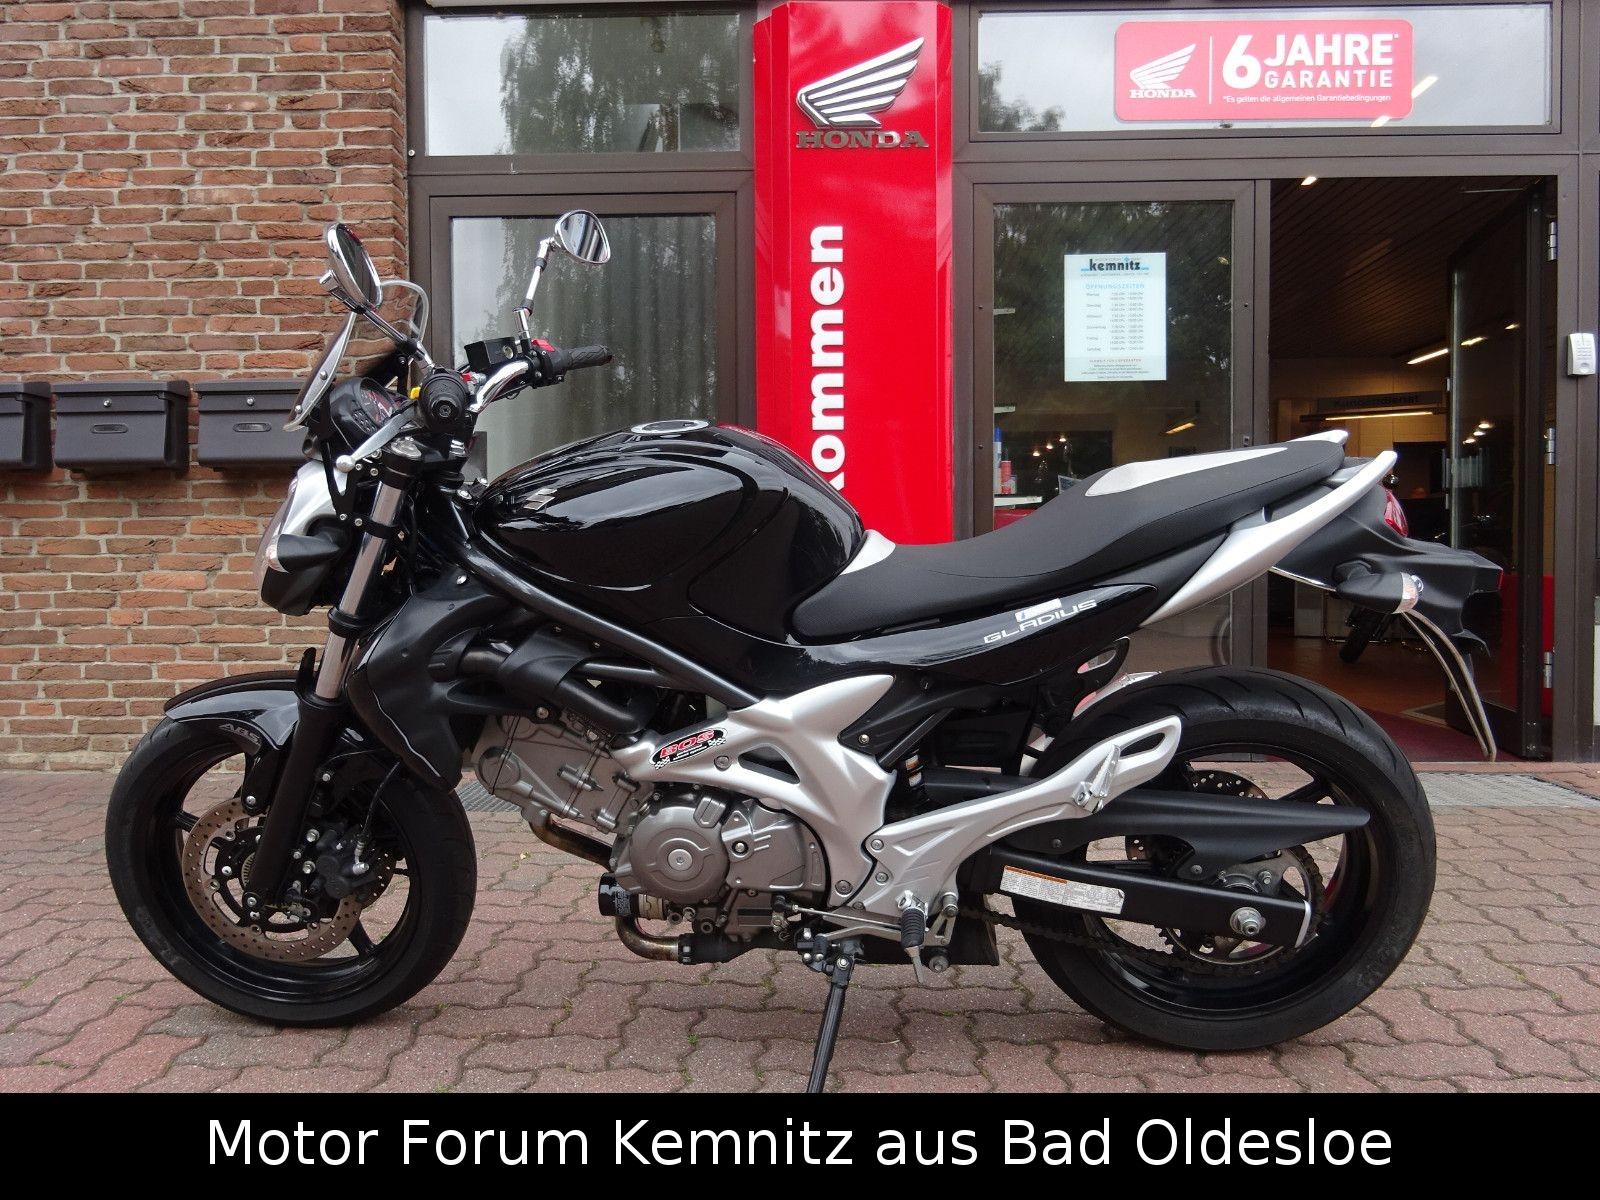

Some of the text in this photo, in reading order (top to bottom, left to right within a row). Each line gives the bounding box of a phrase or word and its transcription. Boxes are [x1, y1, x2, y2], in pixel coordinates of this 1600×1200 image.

[1222, 34, 1261, 89] 6
[1264, 69, 1393, 89] GARANTIE
[1129, 88, 1198, 99] HONDA
[1272, 95, 1315, 103] allgemeinen
[1316, 94, 1391, 103] Garantiebedingungen
[796, 130, 929, 149] HONDA
[1089, 258, 1141, 271] kemnitz
[983, 599, 1098, 644] GLADIUS
[659, 729, 715, 759] BOS
